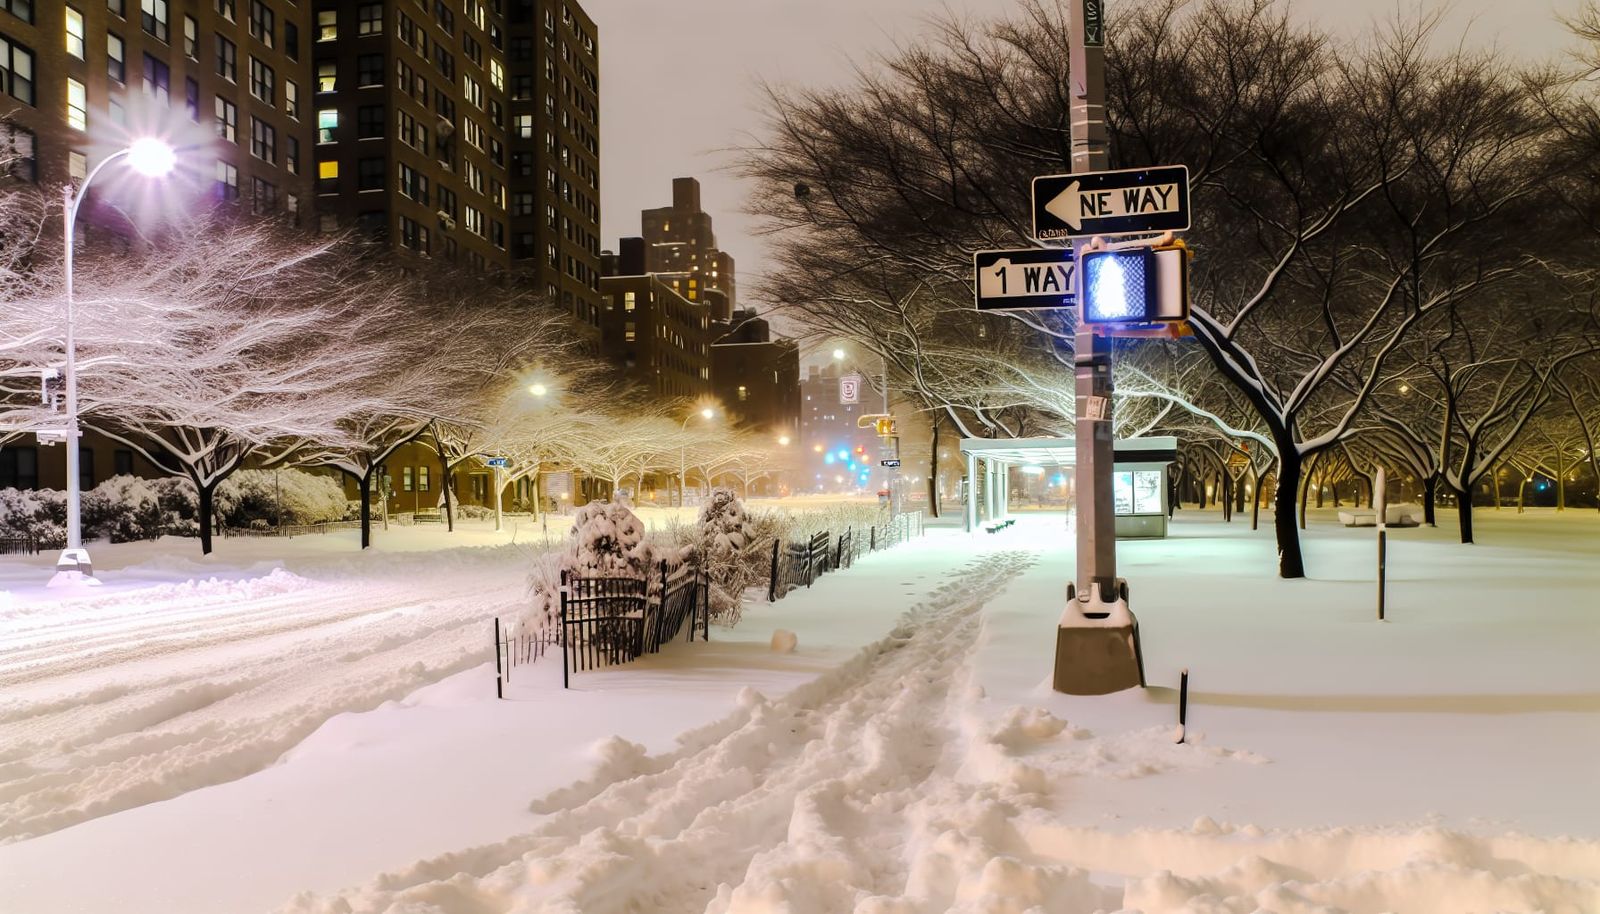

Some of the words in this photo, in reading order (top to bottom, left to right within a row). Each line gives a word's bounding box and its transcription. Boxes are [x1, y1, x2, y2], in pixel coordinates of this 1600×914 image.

[1123, 185, 1173, 214] WAY
[994, 266, 1007, 295] 1
[1024, 265, 1075, 293] WAY
